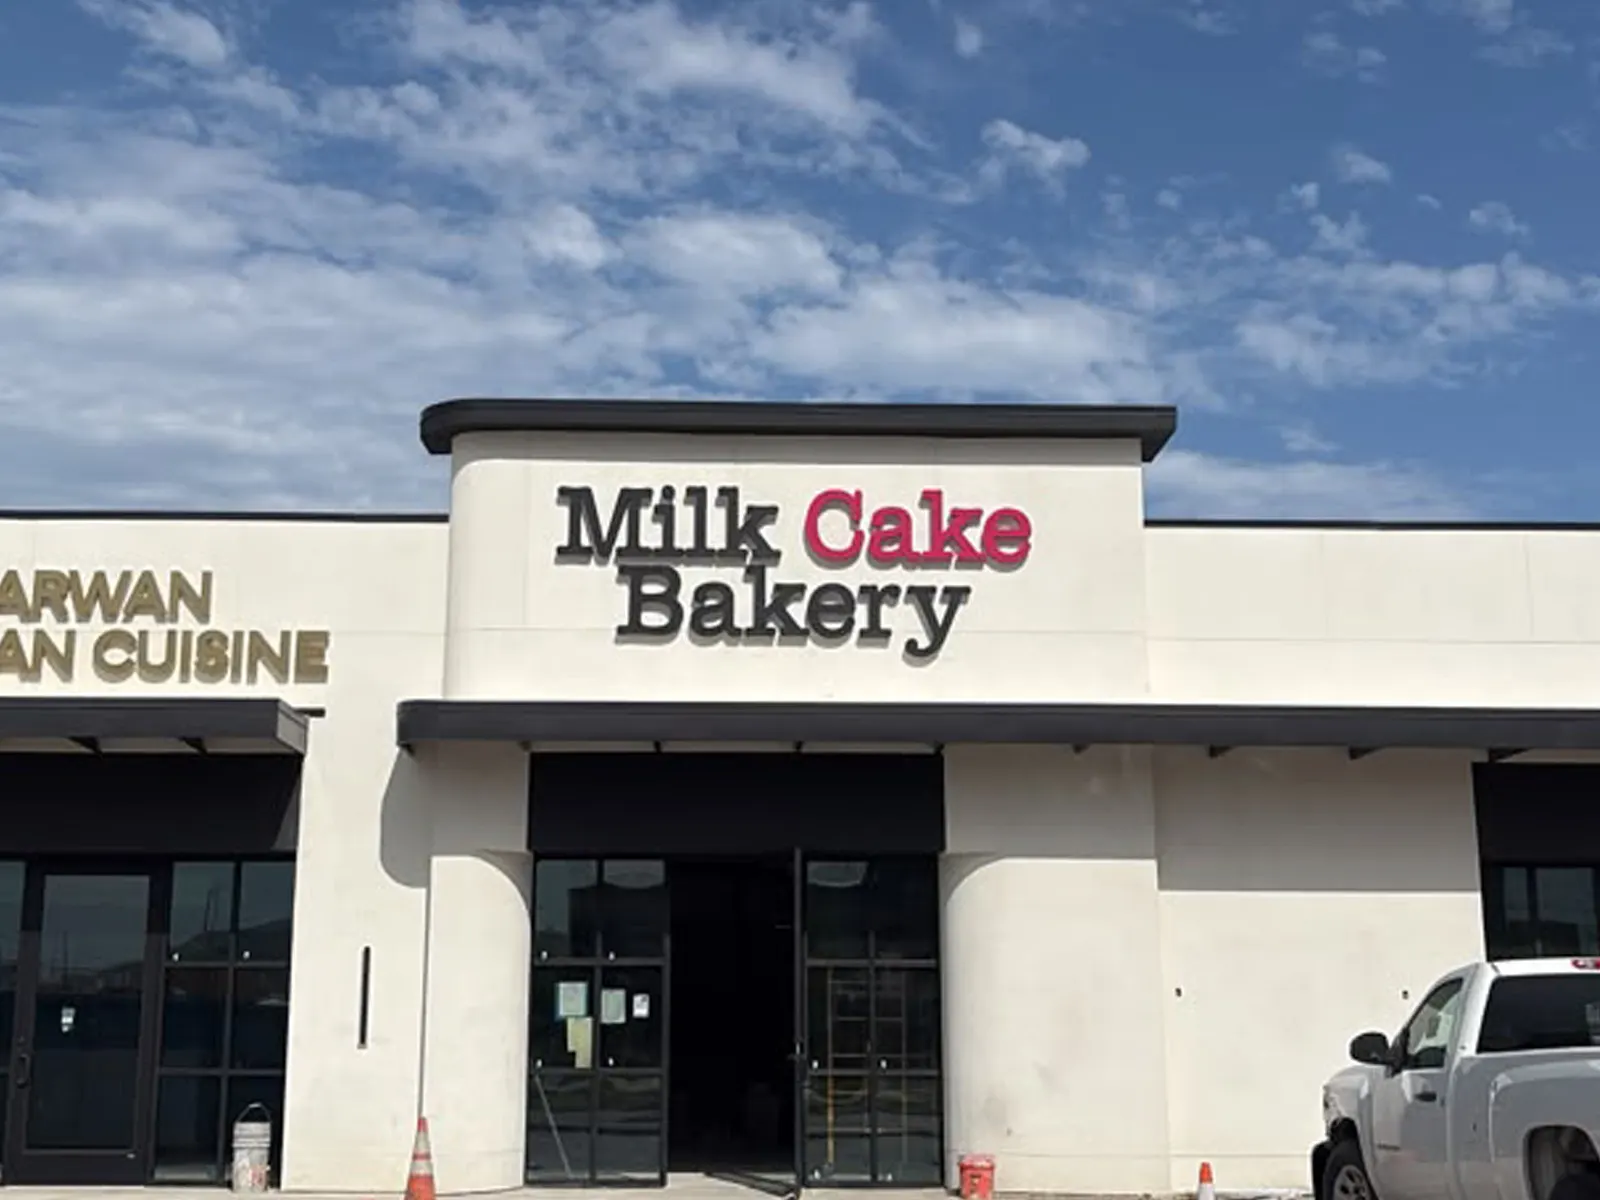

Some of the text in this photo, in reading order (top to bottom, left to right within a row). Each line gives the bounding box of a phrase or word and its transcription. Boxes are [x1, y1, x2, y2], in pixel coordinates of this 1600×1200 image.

[555, 485, 1032, 571] Milk Cake
[92, 629, 330, 685] CUISINE
[615, 564, 971, 666] Bakery
